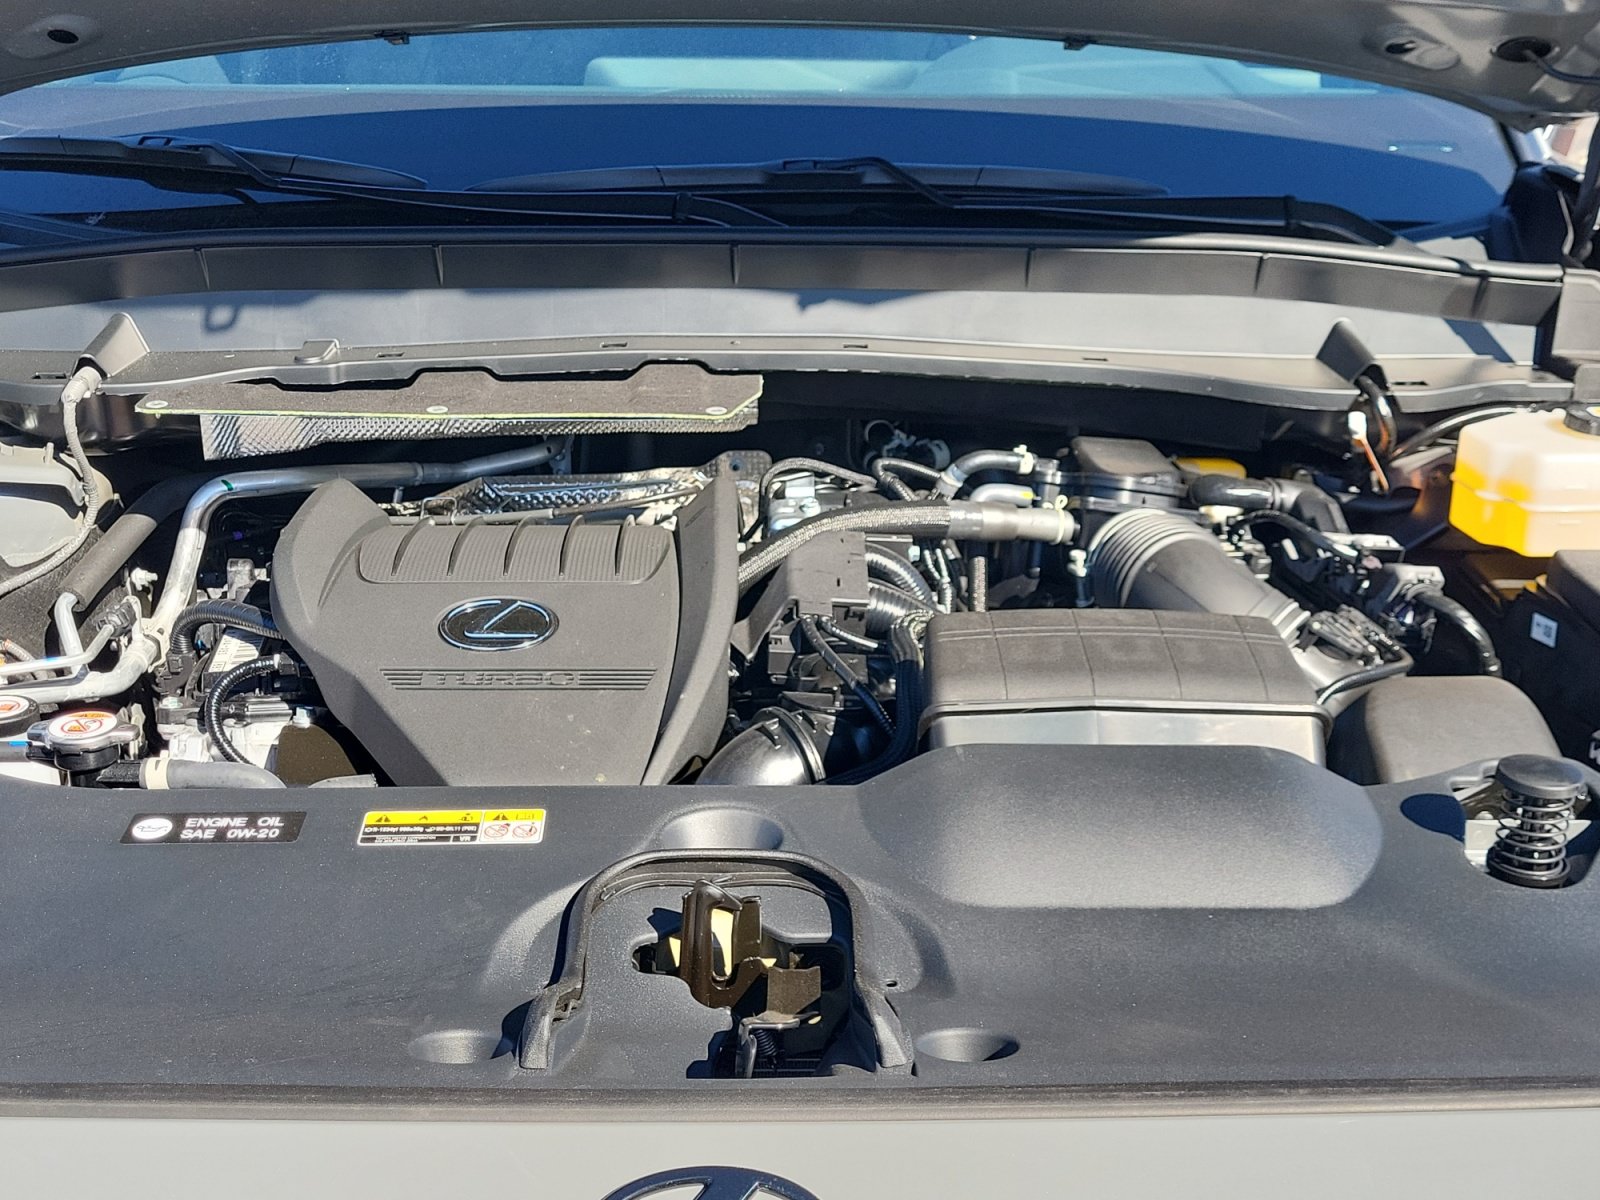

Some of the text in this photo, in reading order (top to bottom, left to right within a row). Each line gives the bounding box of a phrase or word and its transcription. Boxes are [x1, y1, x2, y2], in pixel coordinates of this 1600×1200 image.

[424, 671, 575, 687] TURBO
[185, 816, 284, 828] ENGINE OIL
[180, 829, 279, 839] SAE 0W-20
